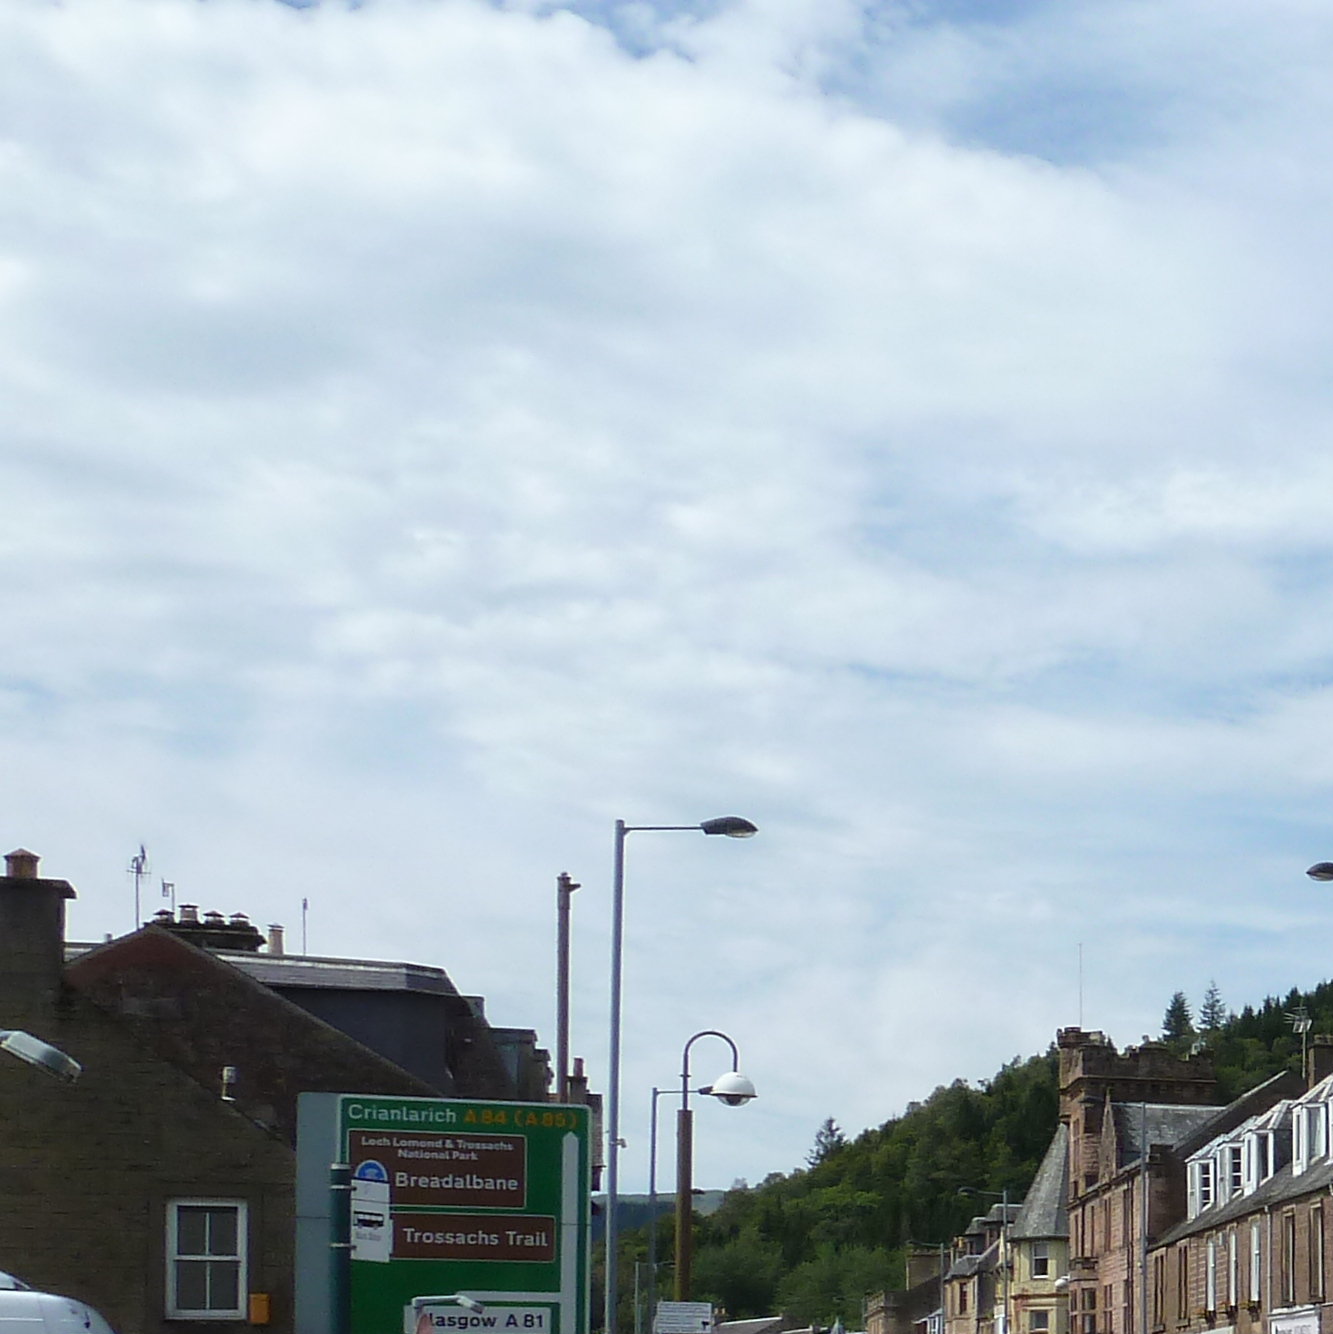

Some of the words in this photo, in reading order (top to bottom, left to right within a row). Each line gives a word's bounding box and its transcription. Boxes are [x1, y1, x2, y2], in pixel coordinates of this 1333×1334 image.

[348, 1103, 457, 1124] Crianlarich
[361, 1136, 391, 1147] Loch
[393, 1137, 443, 1149] Lomond
[445, 1138, 454, 1149] &
[456, 1139, 514, 1151] Trossachs
[398, 1149, 449, 1160] National
[452, 1151, 479, 1161] Park
[395, 1172, 519, 1191] Breadalbane
[403, 1228, 500, 1246] Trossachs
[506, 1231, 549, 1247] Trail
[430, 1314, 499, 1330] lasgow
